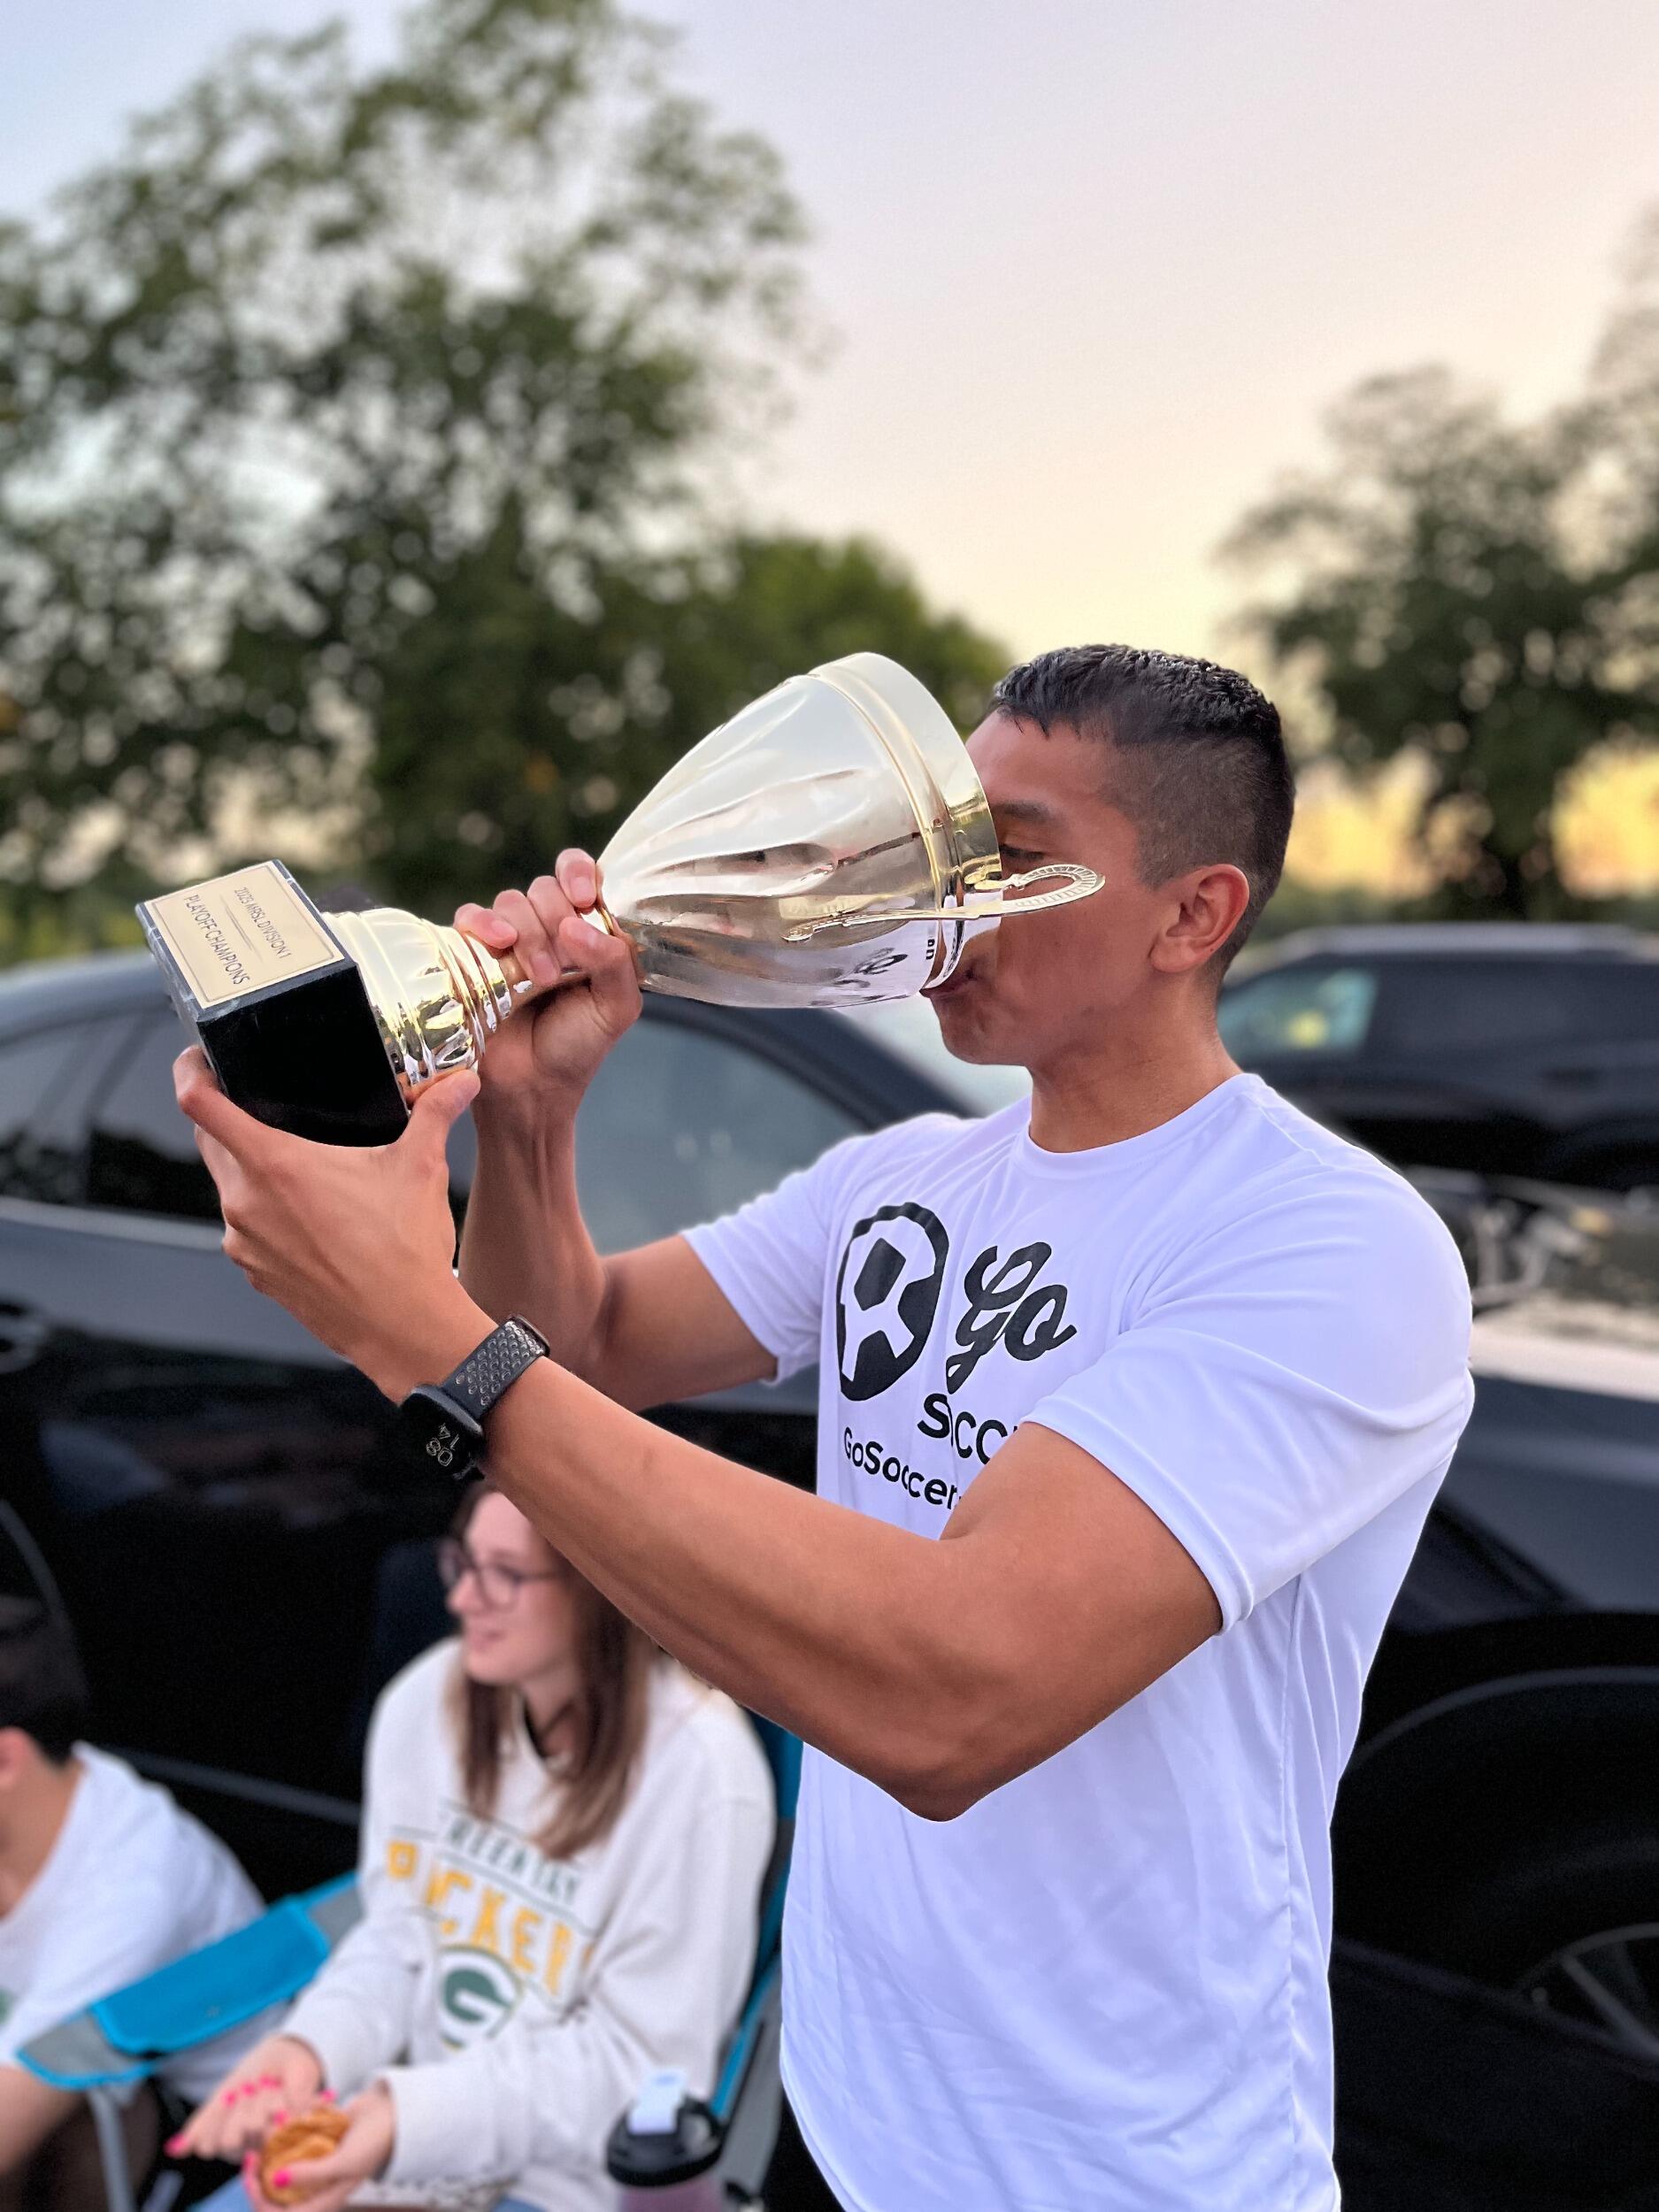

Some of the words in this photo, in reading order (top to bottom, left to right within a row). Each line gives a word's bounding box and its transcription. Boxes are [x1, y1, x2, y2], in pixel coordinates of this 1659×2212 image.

[234, 887, 255, 904] 2023
[244, 902, 265, 923] MRSL
[183, 894, 219, 930] PLAYOFF
[204, 929, 250, 985] CHAMPIONS
[257, 920, 288, 956] DIVISION
[946, 1241, 1078, 1394] Go
[843, 1426, 962, 1510] GoSoccer
